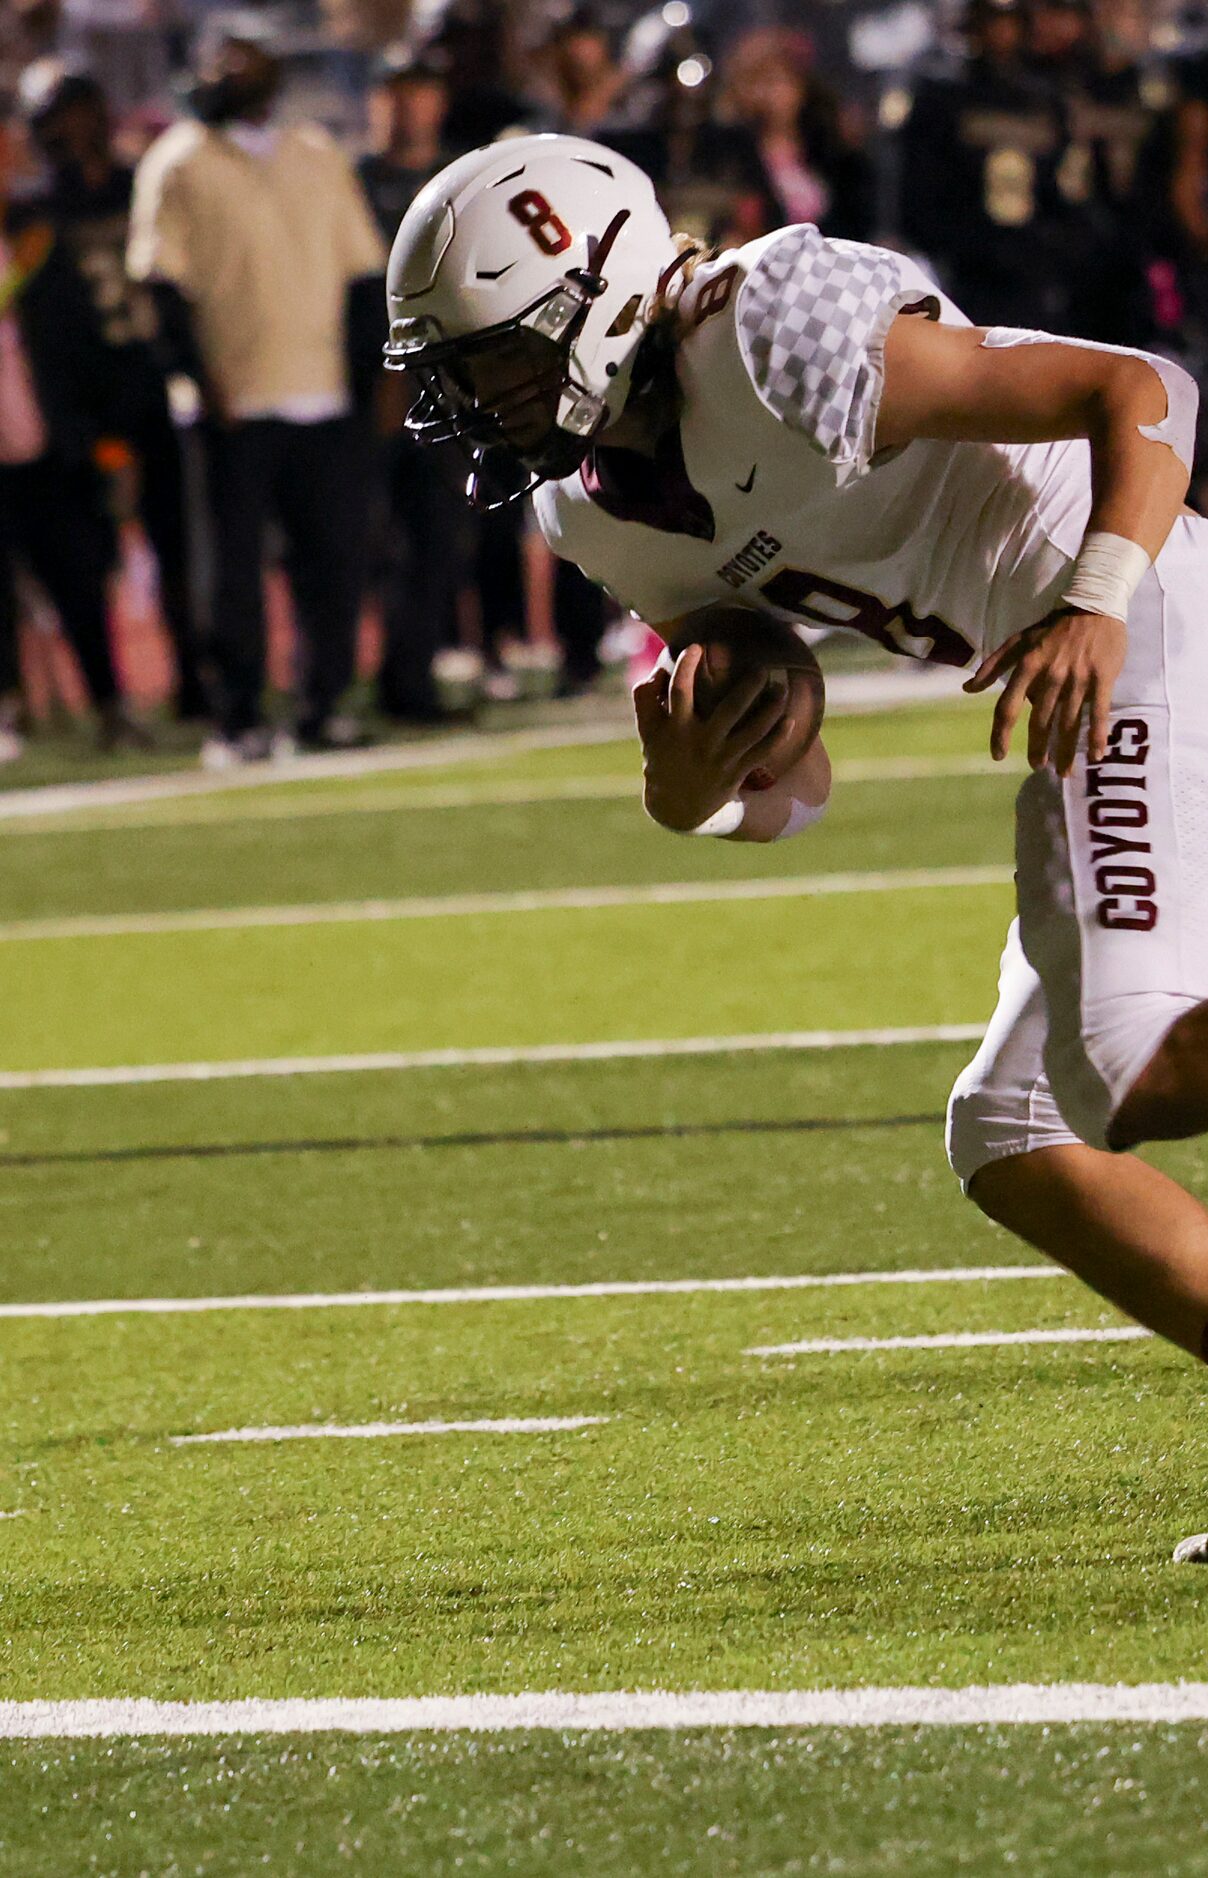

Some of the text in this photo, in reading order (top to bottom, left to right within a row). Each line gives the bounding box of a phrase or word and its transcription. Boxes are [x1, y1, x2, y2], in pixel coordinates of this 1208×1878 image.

[507, 188, 573, 257] 8
[716, 529, 783, 589] COYOTES
[758, 565, 977, 668] 8
[1086, 718, 1158, 932] COYOTES
